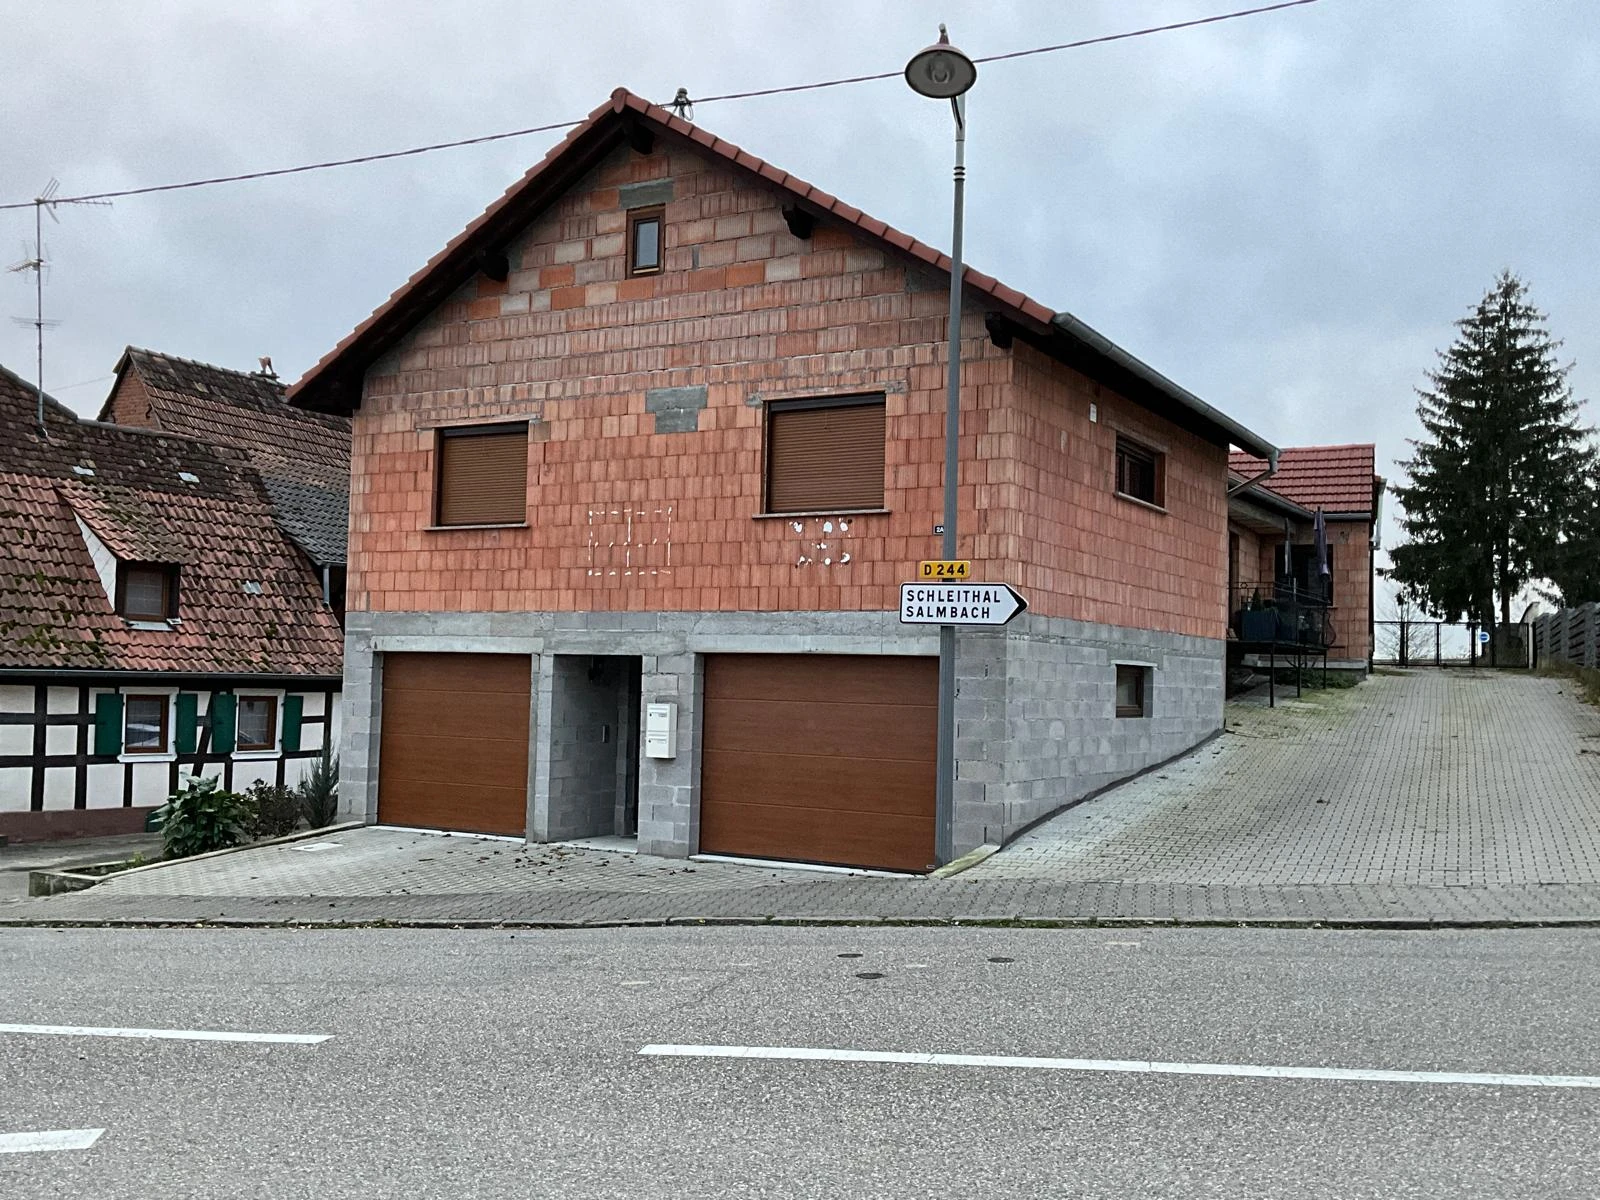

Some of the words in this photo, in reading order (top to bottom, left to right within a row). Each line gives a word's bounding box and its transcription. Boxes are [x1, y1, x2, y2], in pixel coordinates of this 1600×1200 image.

[924, 564, 932, 575] D
[936, 564, 965, 575] 244
[906, 589, 1001, 603] SCHLEITHAL
[906, 605, 990, 619] SALMBACH
